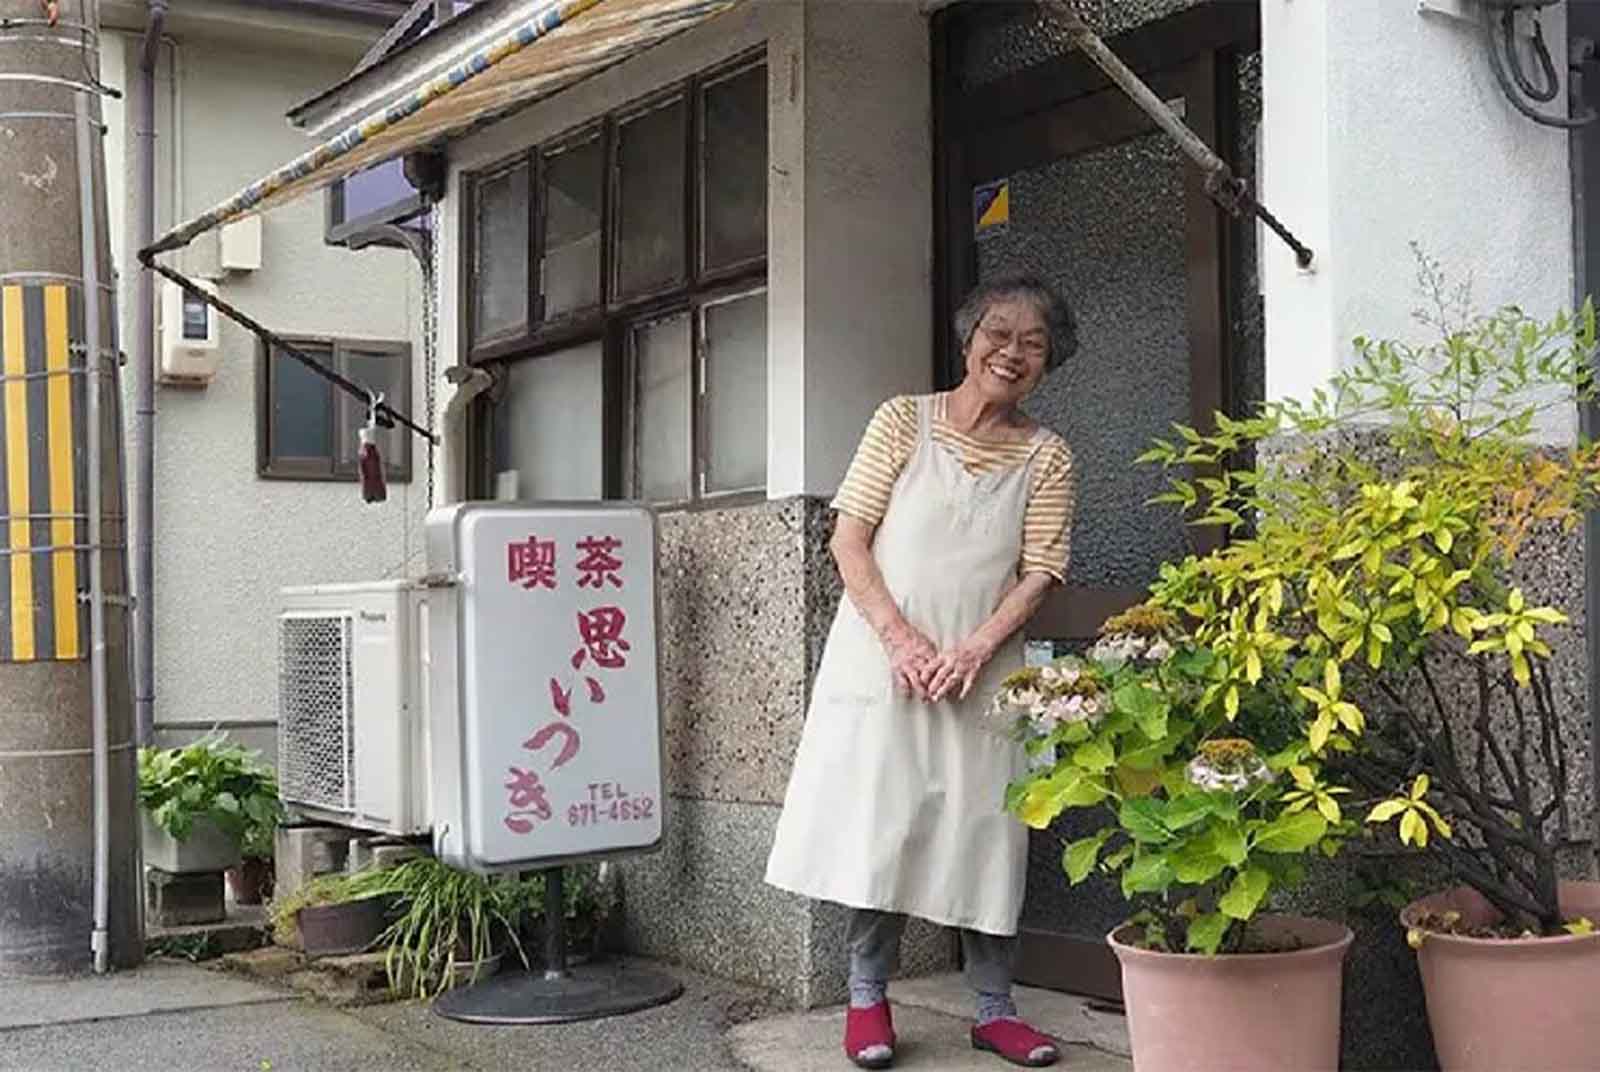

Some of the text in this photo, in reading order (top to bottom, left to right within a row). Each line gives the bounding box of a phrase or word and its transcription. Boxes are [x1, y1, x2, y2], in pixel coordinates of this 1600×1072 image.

[507, 535, 624, 589] 喫茶
[504, 606, 631, 834] 思いつき
[588, 782, 628, 800] TEL
